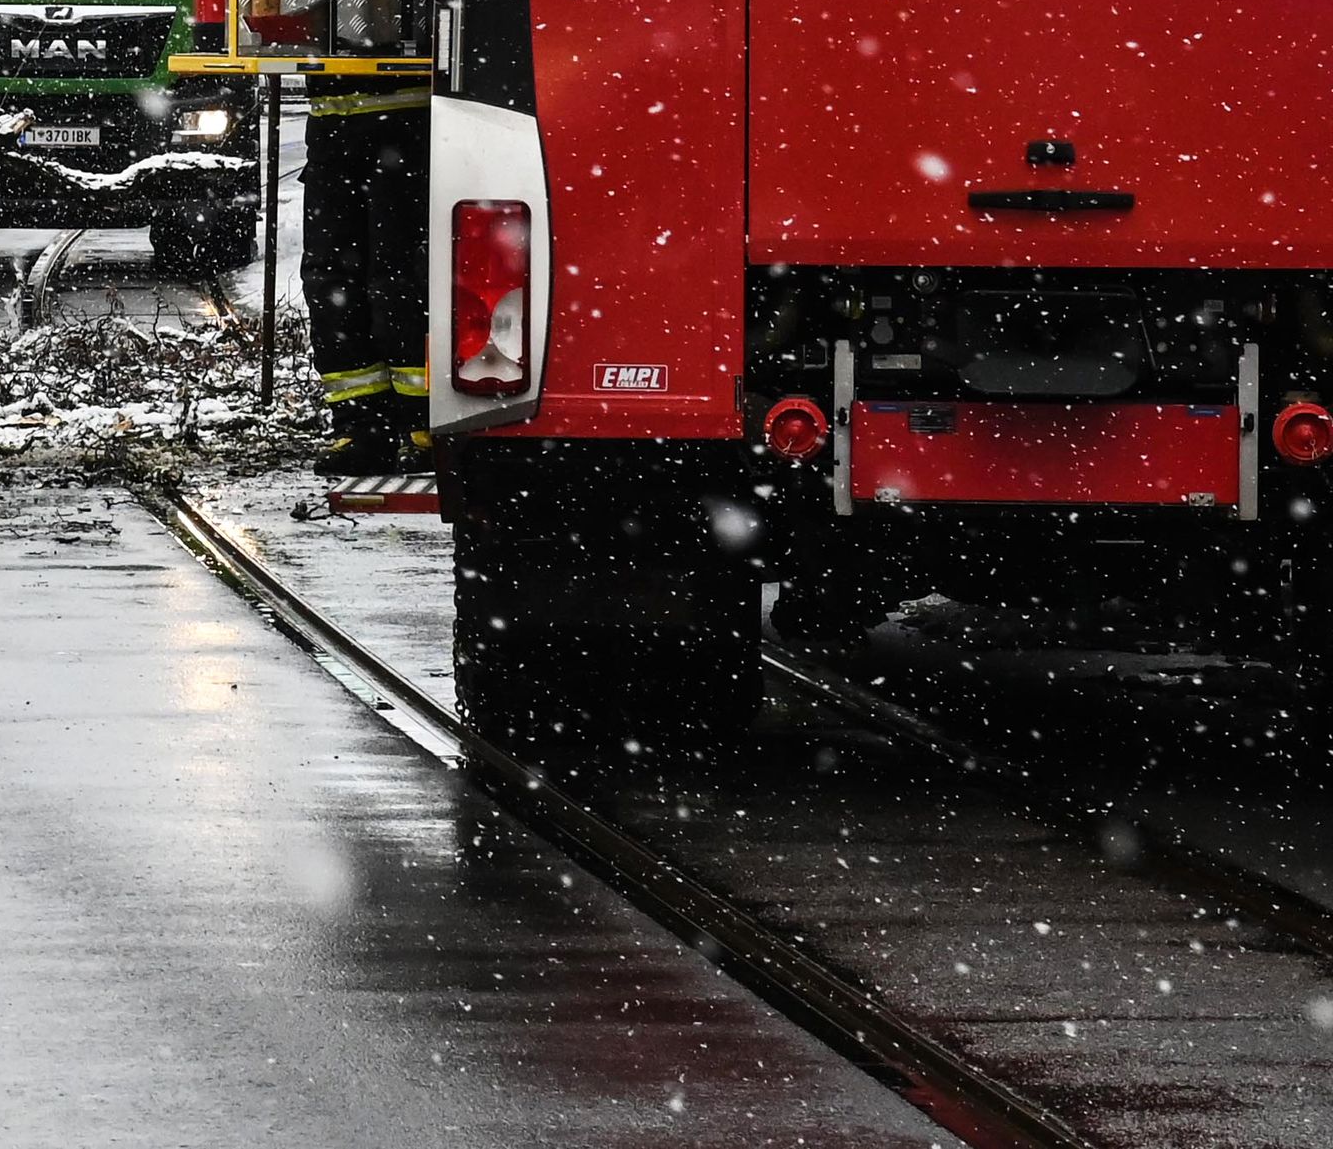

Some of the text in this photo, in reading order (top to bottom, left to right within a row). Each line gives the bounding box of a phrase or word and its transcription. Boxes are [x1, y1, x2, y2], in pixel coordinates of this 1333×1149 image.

[11, 39, 106, 59] MAN
[45, 130, 69, 143] 370
[72, 130, 92, 143] IBK
[601, 367, 660, 389] EMPL
